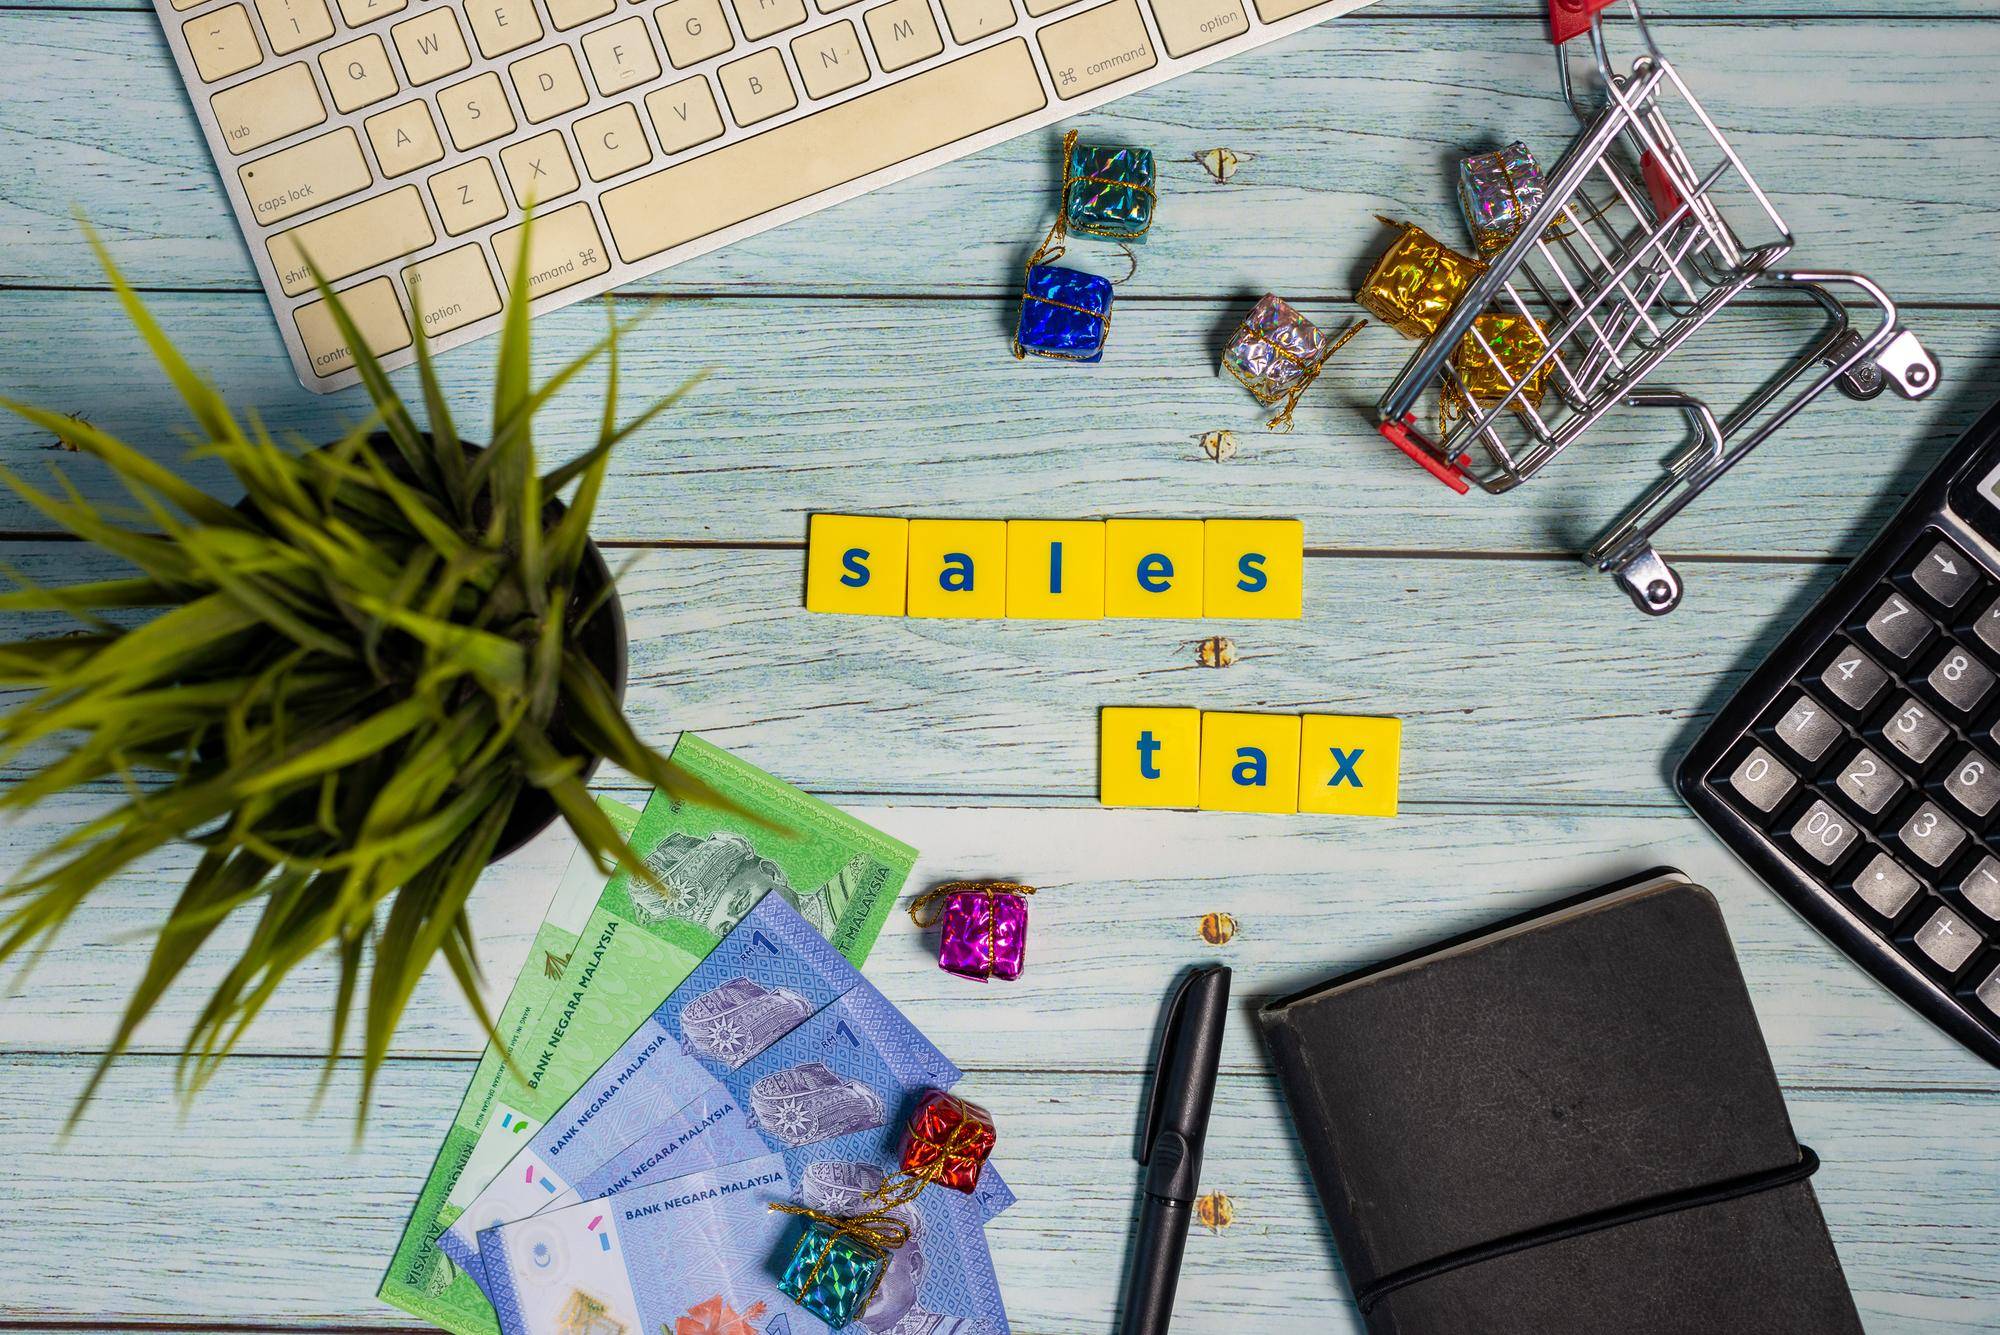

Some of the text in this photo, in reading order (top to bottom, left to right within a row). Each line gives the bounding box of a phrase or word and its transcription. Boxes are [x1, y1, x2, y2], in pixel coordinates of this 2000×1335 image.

[494, 8, 508, 27] E
[686, 17, 702, 36] G
[1200, 11, 1238, 33] option
[894, 20, 914, 41] M
[417, 33, 438, 55] W
[613, 45, 624, 64] F
[820, 47, 838, 68] N
[1086, 45, 1146, 76] command
[349, 62, 366, 80] Q
[539, 73, 554, 91] D
[749, 76, 763, 94] B
[468, 101, 481, 119] S
[673, 102, 687, 121] V
[229, 125, 250, 140] tab
[396, 129, 411, 147] A
[603, 132, 619, 150] C
[528, 159, 547, 180] X
[258, 184, 314, 214] caps lock
[458, 185, 474, 205] Z
[424, 302, 462, 326] option
[840, 541, 1268, 595] sales
[1881, 599, 1909, 624] 7
[1836, 657, 1862, 681] 4
[1943, 655, 1968, 680] 8
[1796, 709, 1815, 731] 1
[1897, 706, 1923, 732] 5
[1136, 730, 1366, 789] tax
[1745, 757, 1769, 782] 0
[1848, 759, 1877, 787] 2
[1959, 761, 1985, 786] 6
[1805, 810, 1844, 847] 00
[1913, 812, 1938, 838] 3
[844, 866, 891, 939] MALAYSIA
[519, 1006, 531, 1025] WANG
[528, 921, 618, 1089] BANK NEGARA MALAYSIA
[550, 1035, 667, 1156] BANK NEGARA MALAYSIA
[631, 1142, 679, 1178] NEGARA
[678, 1103, 734, 1145] MALAYSIA
[625, 1172, 783, 1220] BANK NEGARA MALAYSIA
